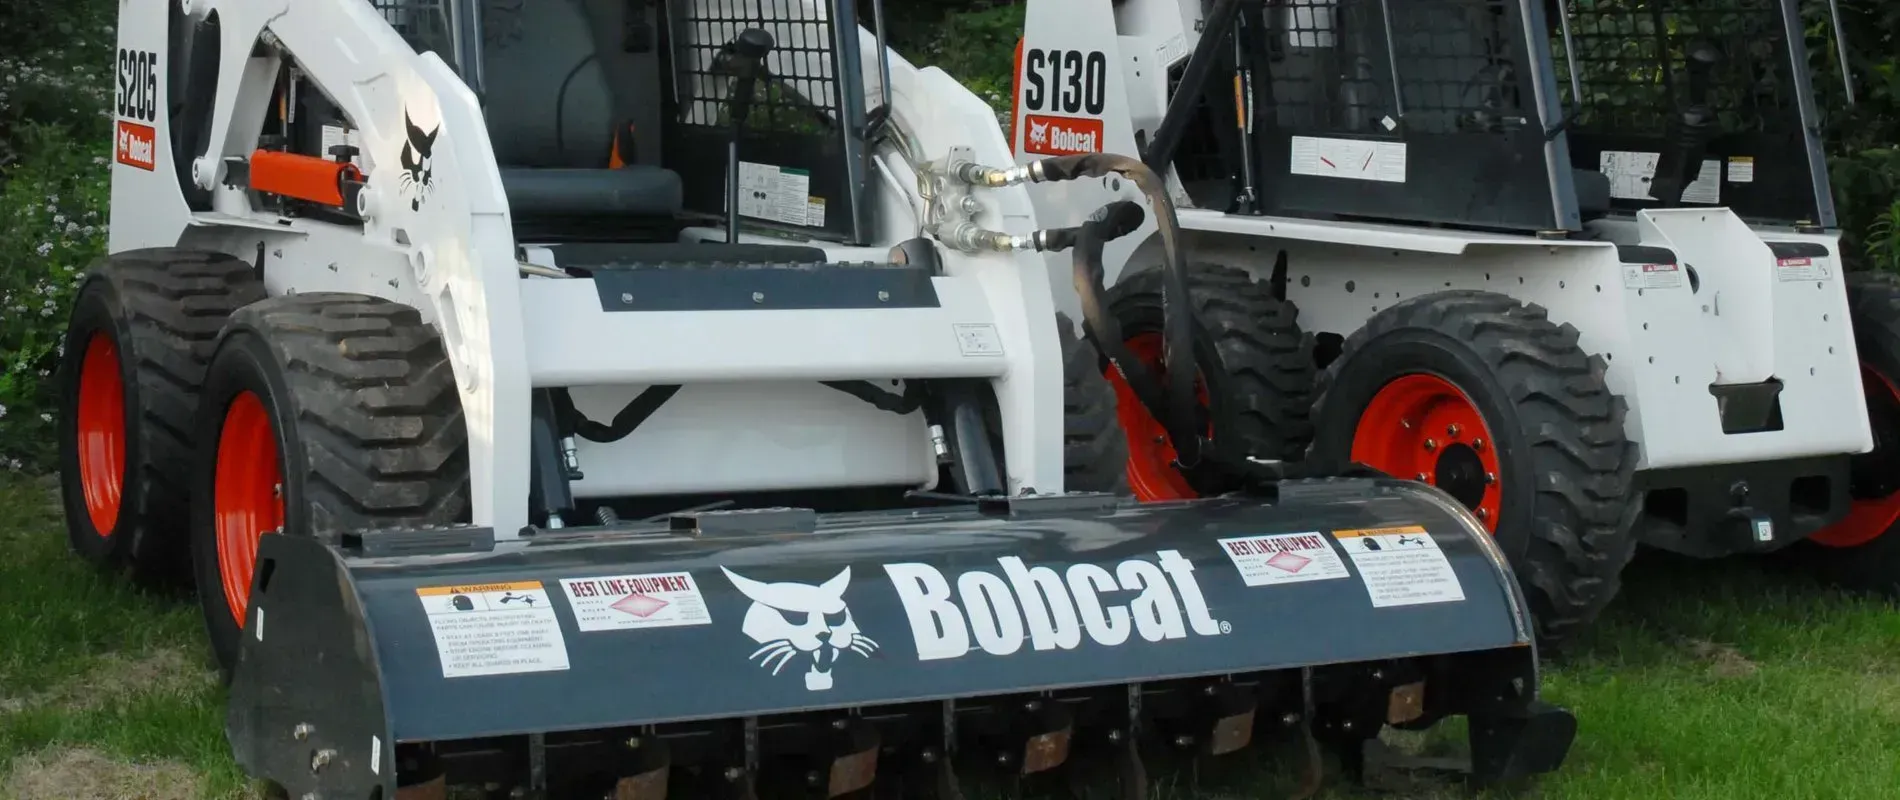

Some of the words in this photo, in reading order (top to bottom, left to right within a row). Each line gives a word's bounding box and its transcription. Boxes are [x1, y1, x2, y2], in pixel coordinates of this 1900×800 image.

[118, 48, 157, 122] S205
[1025, 48, 1106, 115] S130
[129, 133, 153, 164] Bobcat
[1050, 126, 1097, 153] Bobcat
[1226, 541, 1254, 556] BEST
[1249, 539, 1276, 554] LINE
[1271, 535, 1325, 552] EQUIPMENT
[569, 581, 599, 597] BEST
[598, 579, 628, 596] LINE
[627, 575, 691, 595] EQUIPMENT
